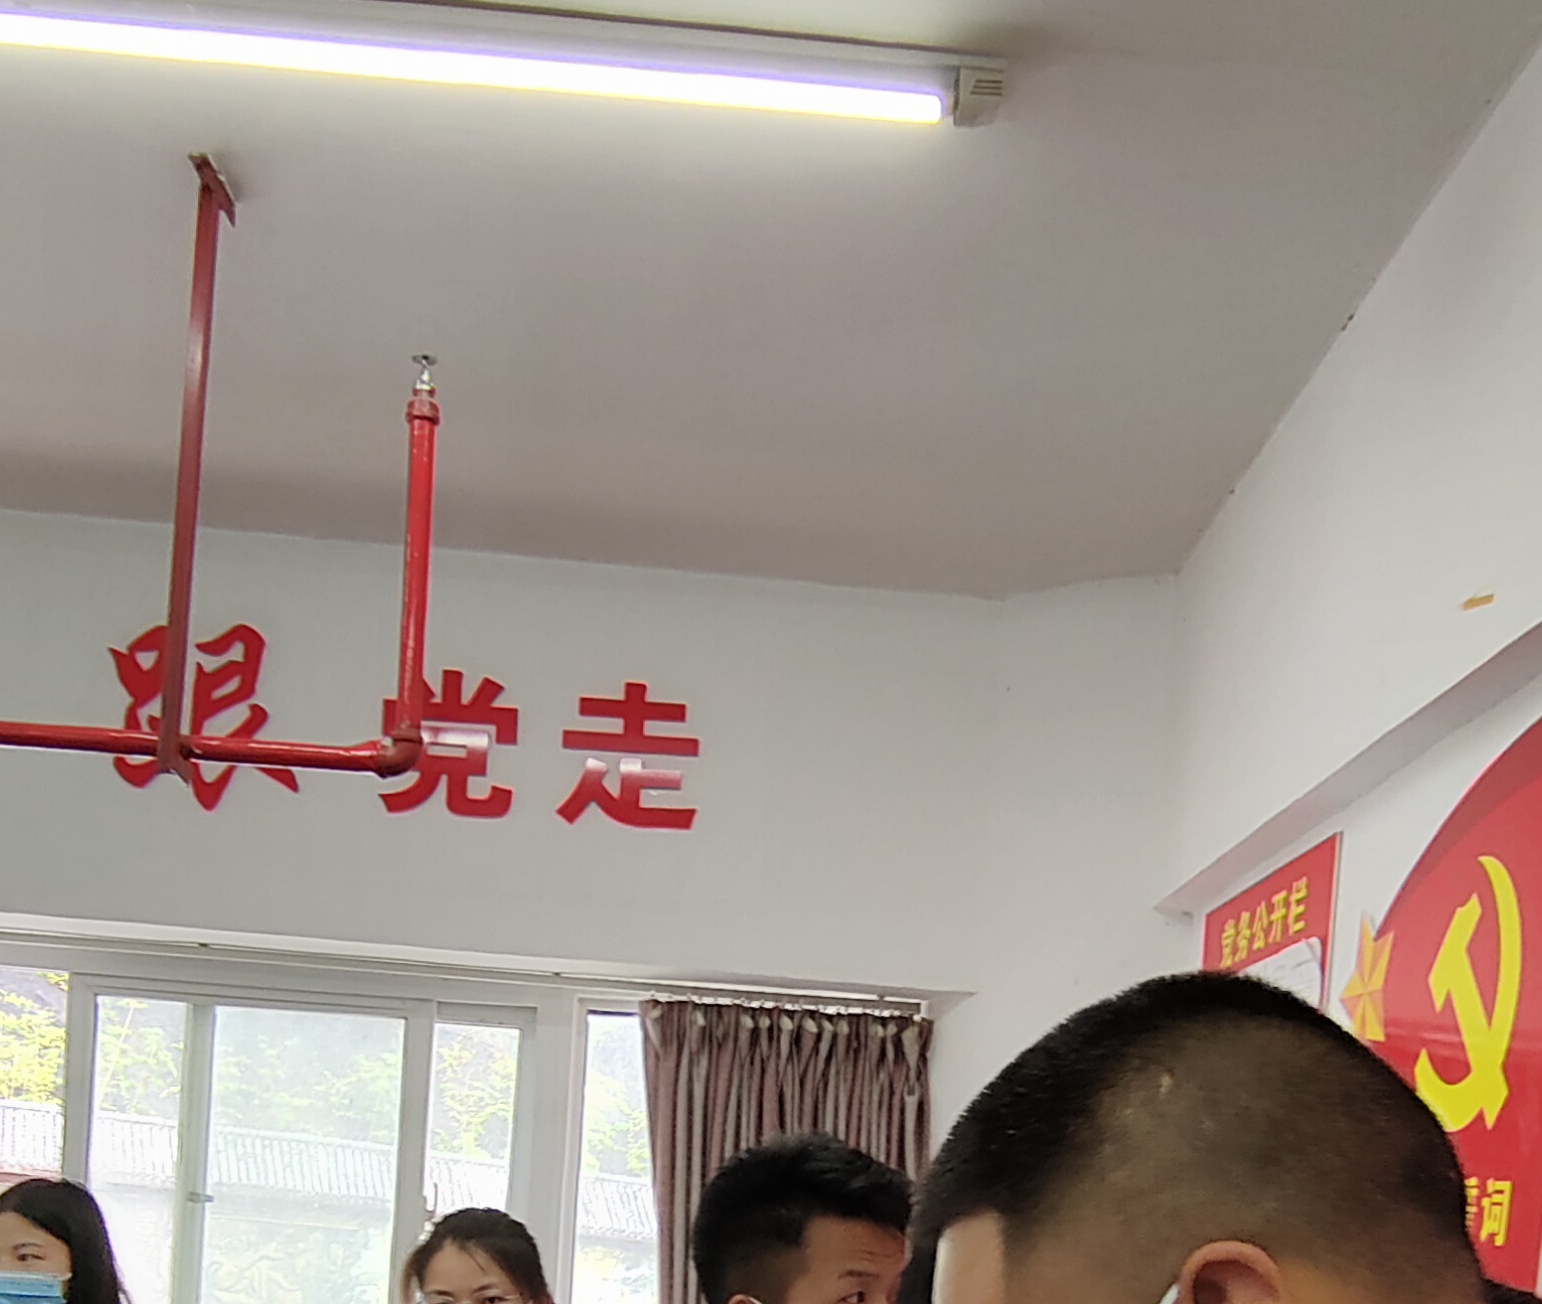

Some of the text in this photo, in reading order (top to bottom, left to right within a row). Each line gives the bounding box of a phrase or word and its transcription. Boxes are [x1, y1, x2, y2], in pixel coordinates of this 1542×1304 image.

[108, 624, 699, 830] 跟党走
[1220, 876, 1309, 968] 党务公开栏
